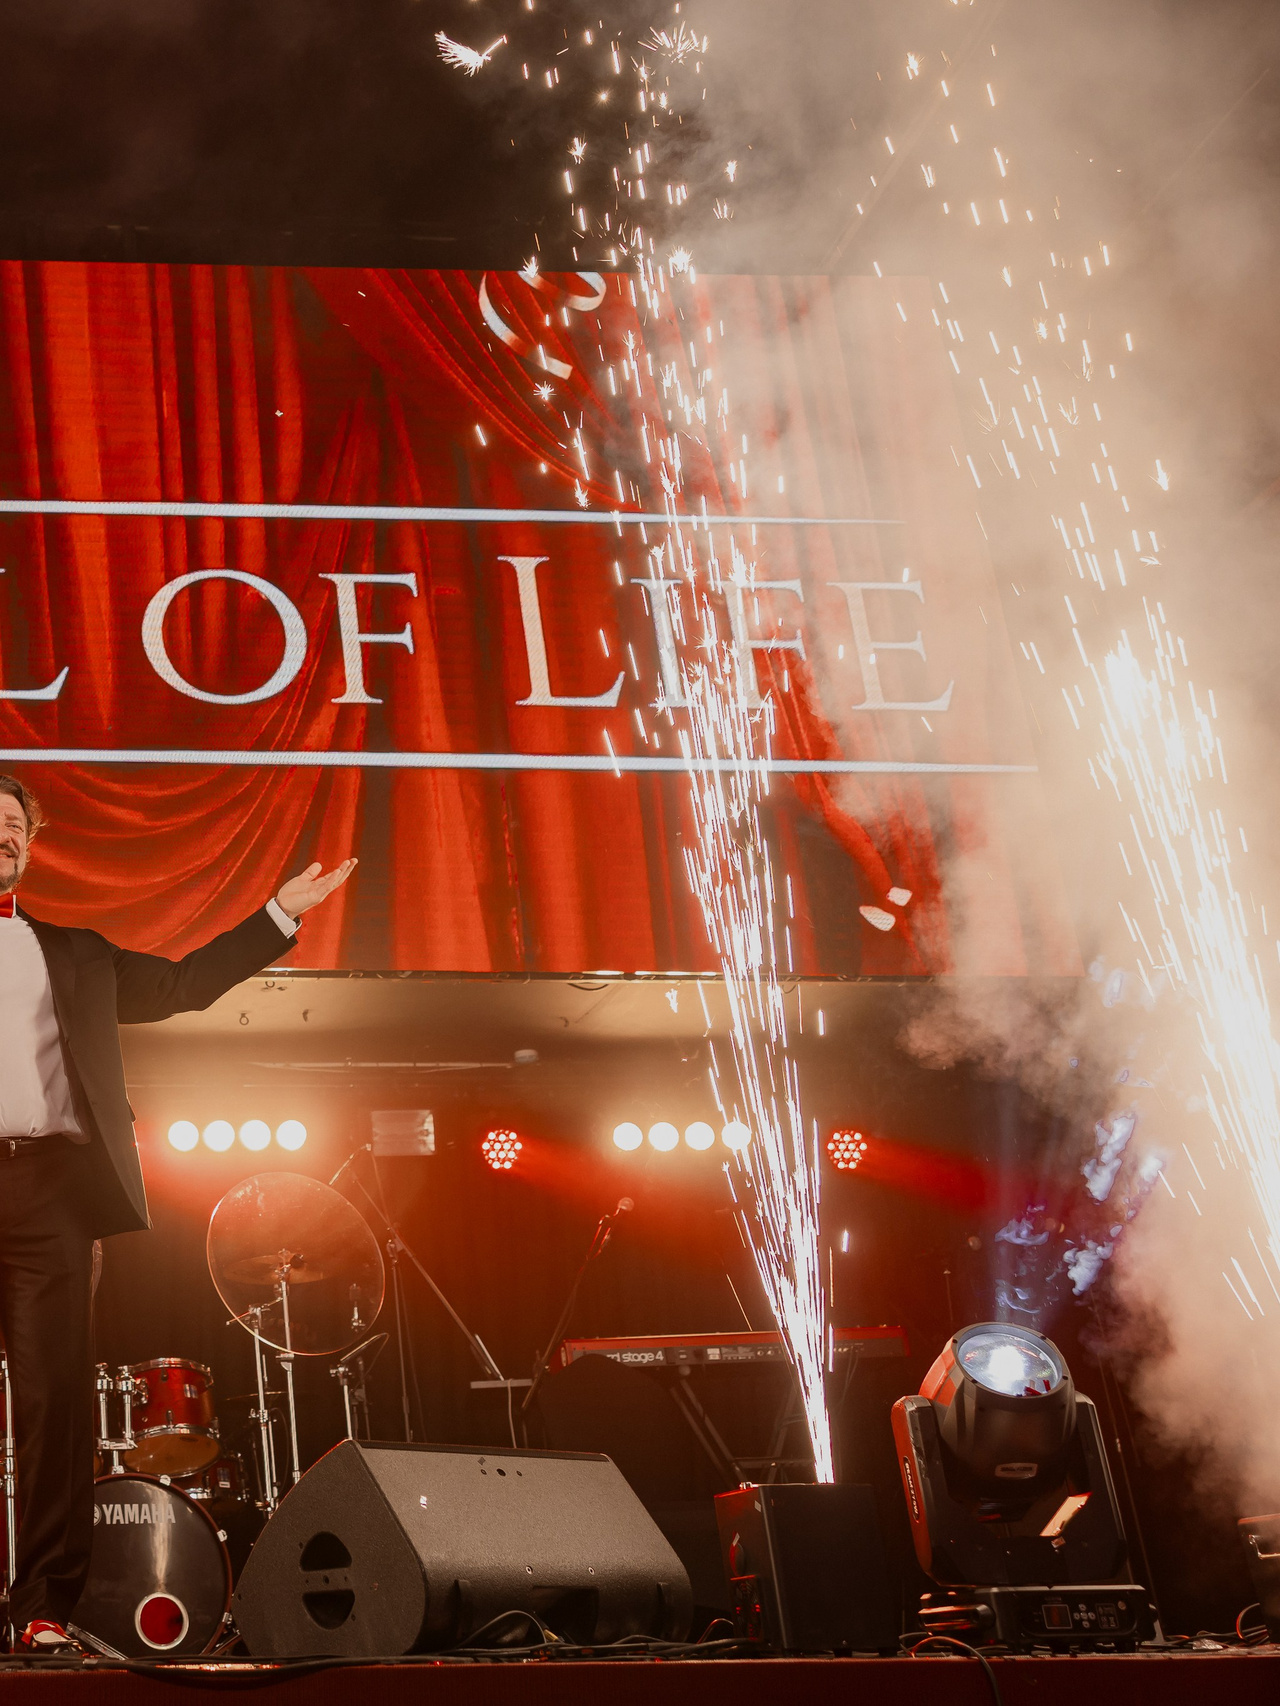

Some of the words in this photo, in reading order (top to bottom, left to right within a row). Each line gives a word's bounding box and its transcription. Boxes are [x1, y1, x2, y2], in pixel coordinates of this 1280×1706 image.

[141, 568, 418, 705] OF
[497, 555, 956, 712] LIFE
[102, 1503, 176, 1525] YAMAHA
